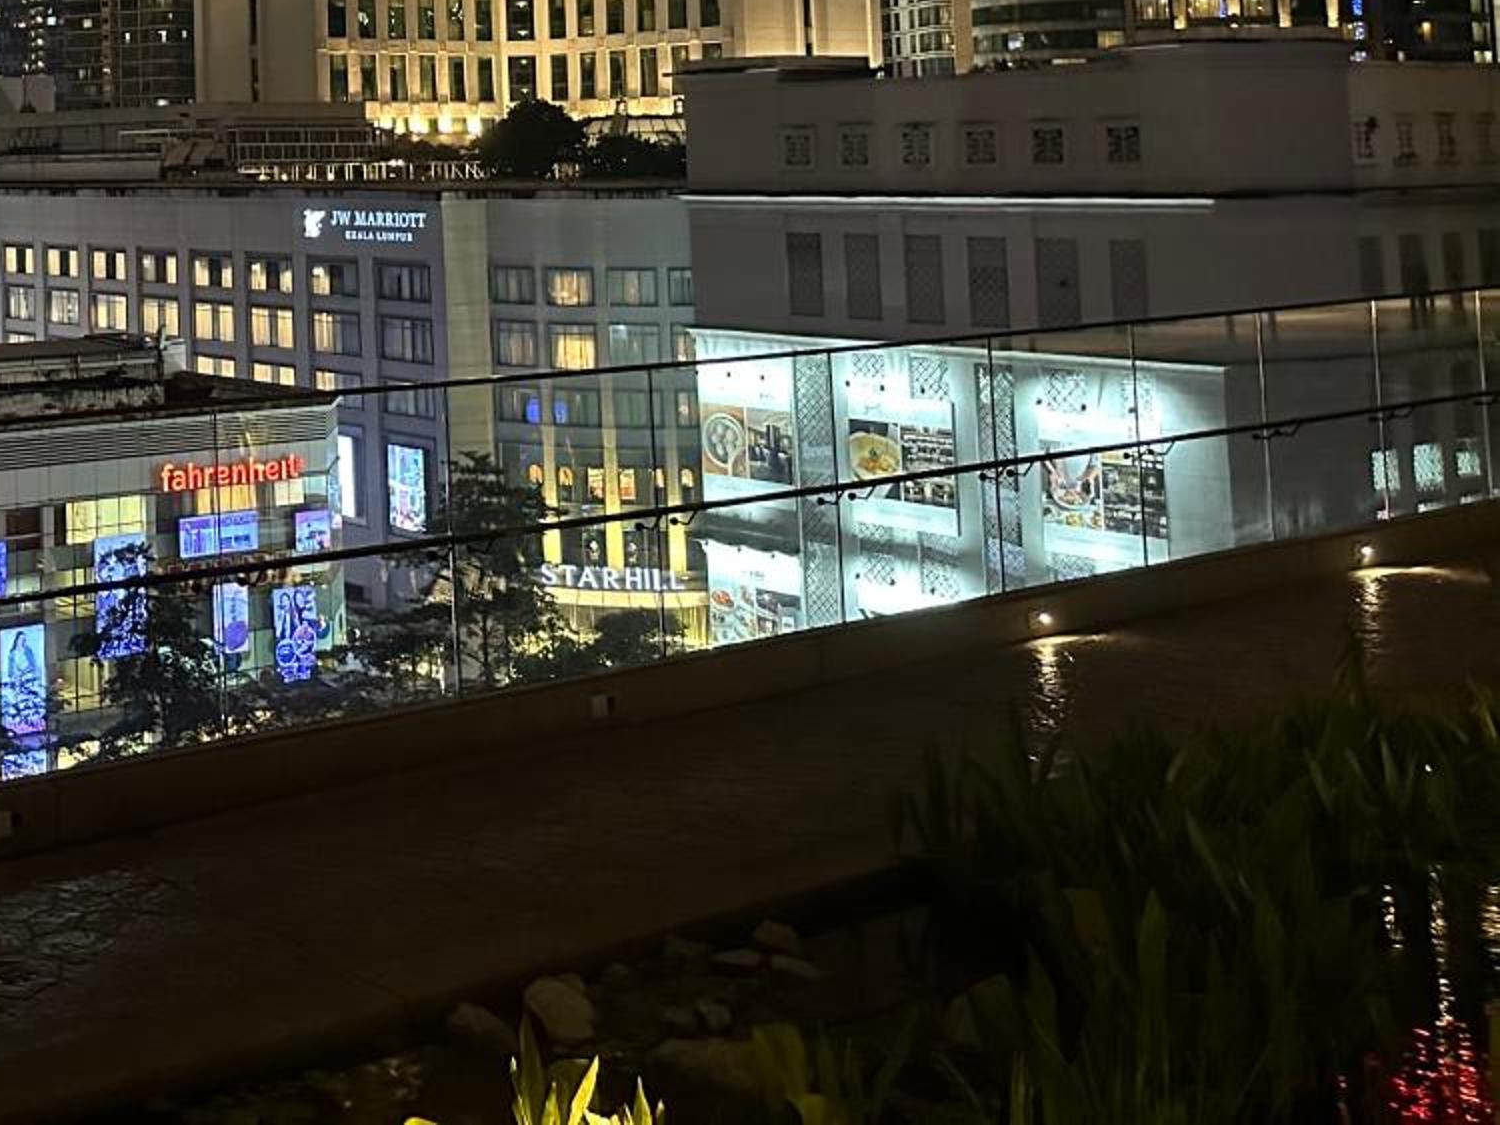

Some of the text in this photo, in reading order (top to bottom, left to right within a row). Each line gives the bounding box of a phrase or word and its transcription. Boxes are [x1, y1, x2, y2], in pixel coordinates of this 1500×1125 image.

[331, 210, 427, 228] JW MARRIOTT
[376, 231, 413, 242] LUMPUR
[161, 453, 299, 492] fahrenheit
[540, 562, 686, 591] STARHILL
